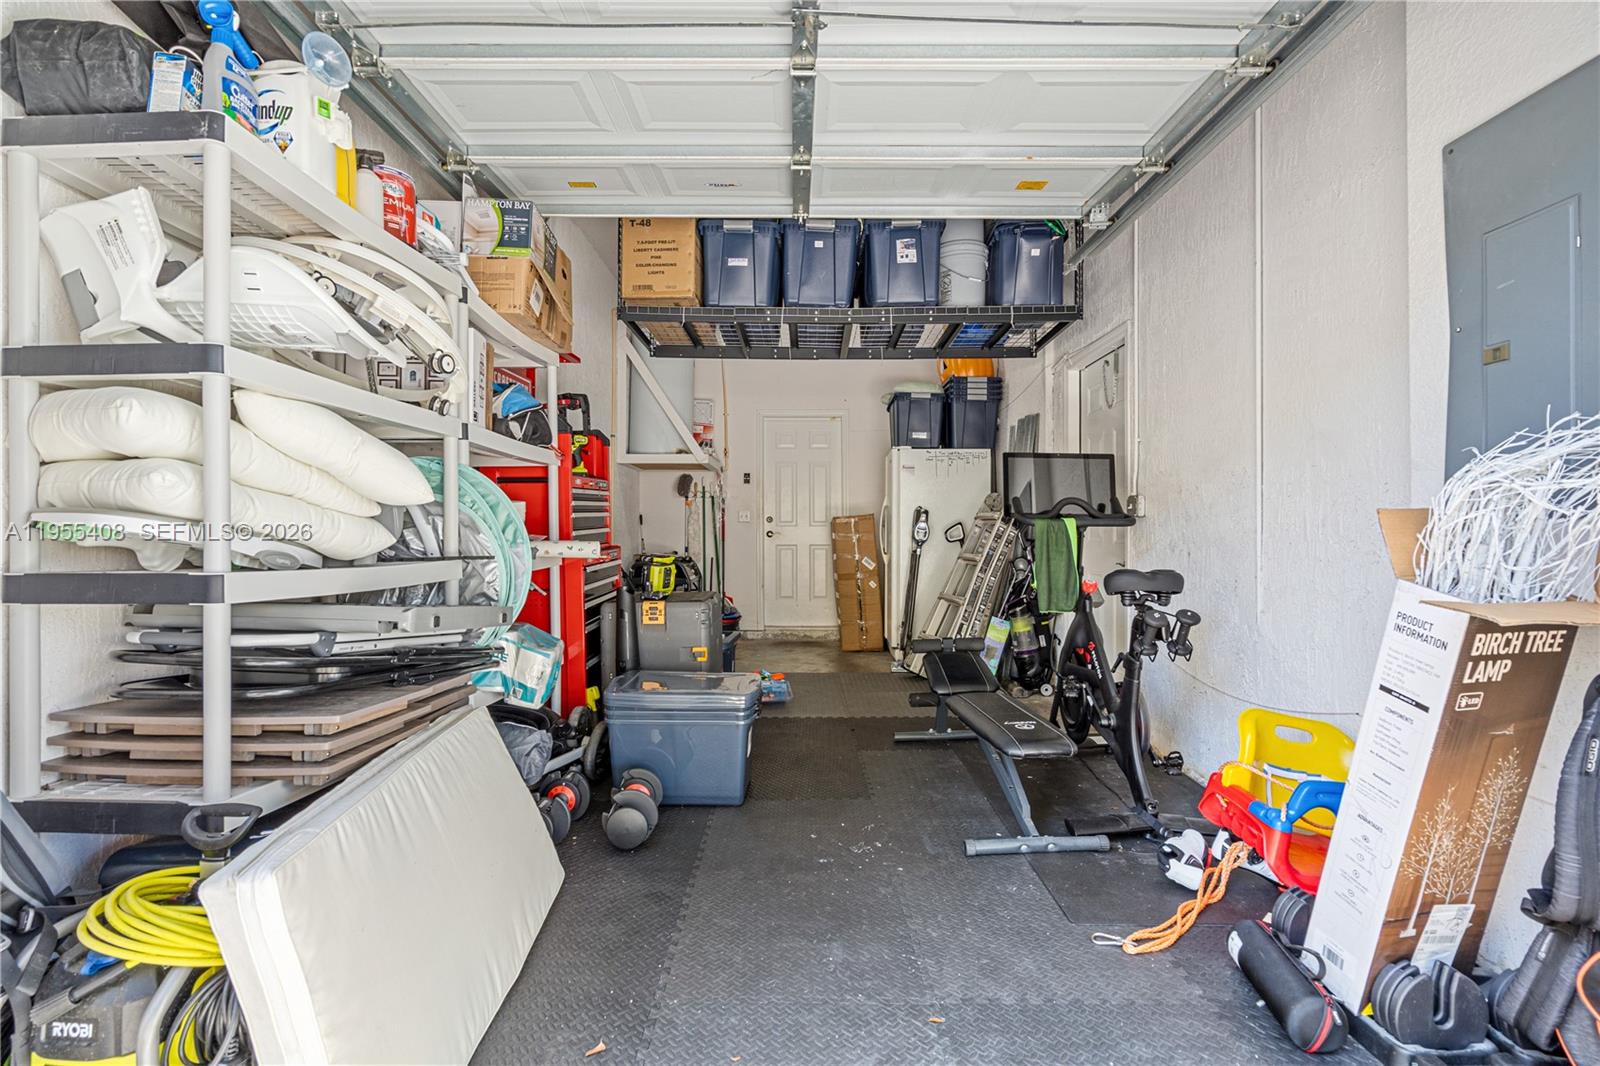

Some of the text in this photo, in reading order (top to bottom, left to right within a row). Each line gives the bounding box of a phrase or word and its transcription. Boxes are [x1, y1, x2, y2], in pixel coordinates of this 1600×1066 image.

[258, 100, 293, 126] ndup
[383, 197, 414, 215] EMIUM
[467, 199, 532, 210] HAMPTON BAY
[629, 219, 652, 227] T-48
[1396, 611, 1434, 632] PRODUCT
[1394, 623, 1448, 651] INFORMATION
[1470, 629, 1567, 657] BIRCH TREE
[1462, 659, 1513, 684] LAMP
[51, 1021, 94, 1039] RYOBI
